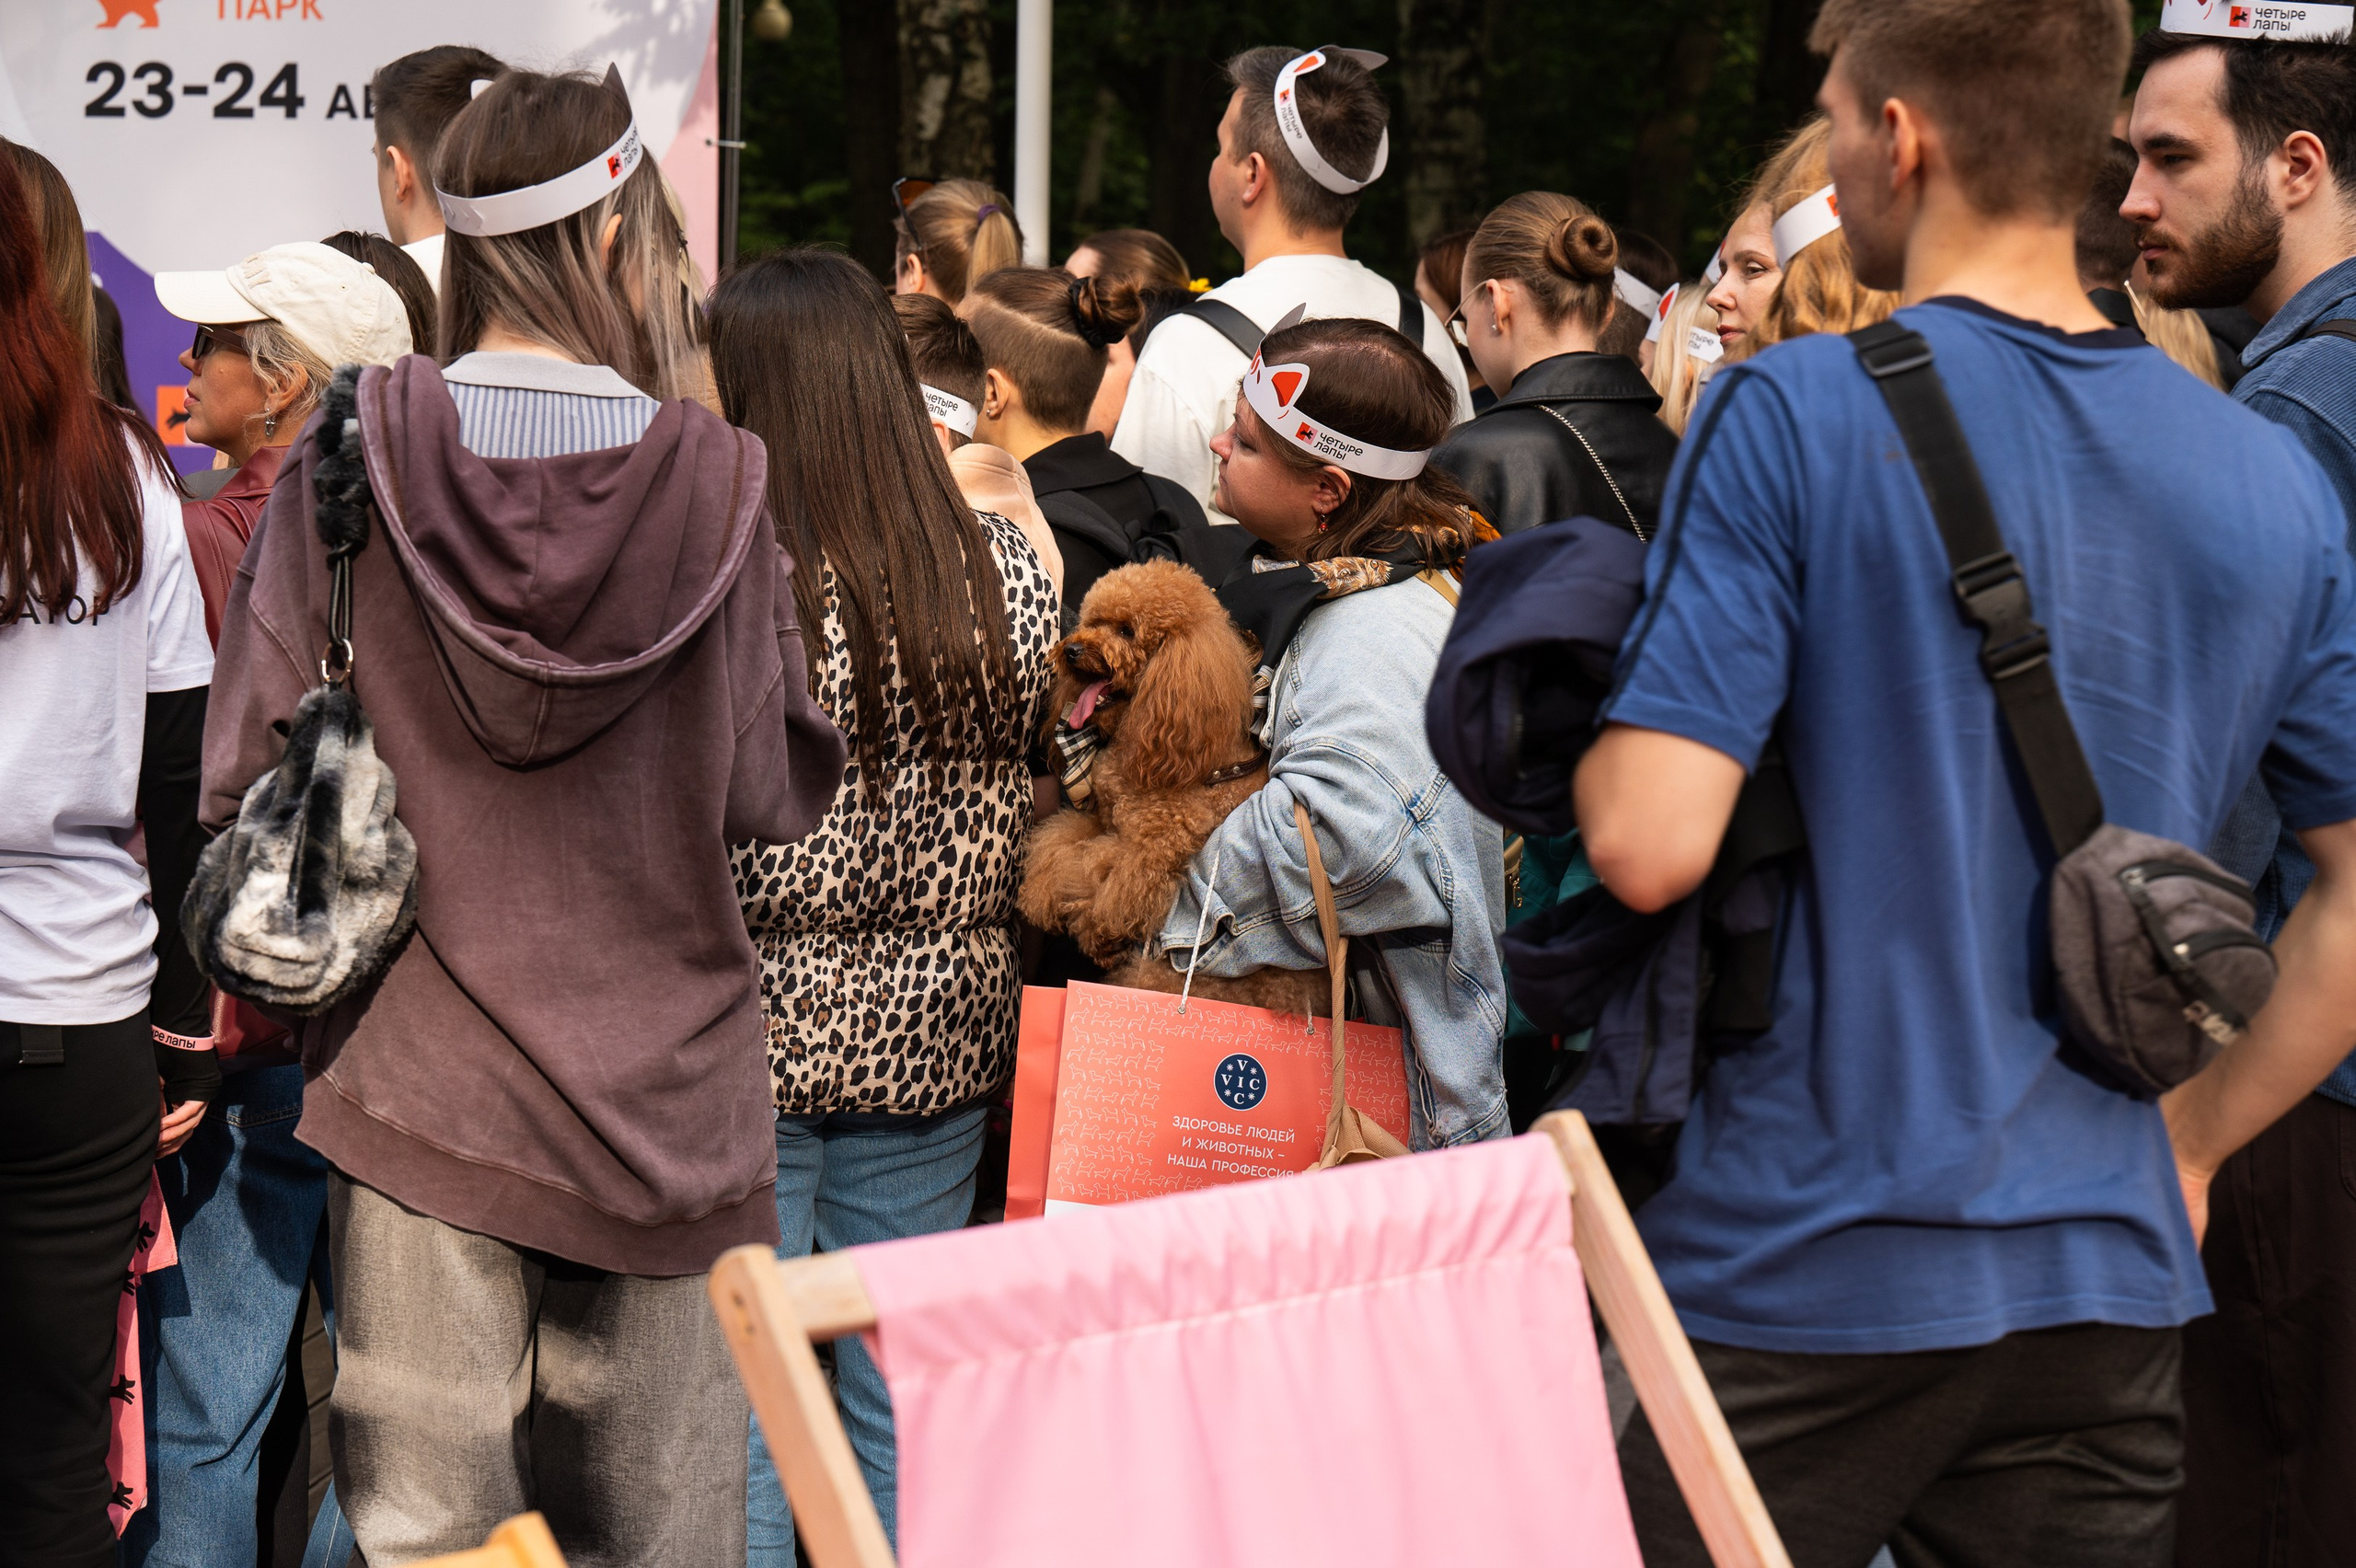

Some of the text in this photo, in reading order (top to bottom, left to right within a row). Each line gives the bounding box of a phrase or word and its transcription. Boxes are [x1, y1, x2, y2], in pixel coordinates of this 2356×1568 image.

[2255, 7, 2306, 20] четыре
[2252, 19, 2291, 31] лапы
[85, 61, 305, 119] 23-24
[925, 392, 959, 411] четыре
[1313, 441, 1347, 460] лапы
[1320, 432, 1363, 456] четыре
[165, 1034, 196, 1049] лапы
[1172, 1115, 1296, 1144] ЗДОРОВЬЕ ЛЮДЕЙ
[1182, 1136, 1192, 1148] И
[1195, 1137, 1275, 1159] ЖИВОТНЫХ
[1167, 1153, 1207, 1170] НАША
